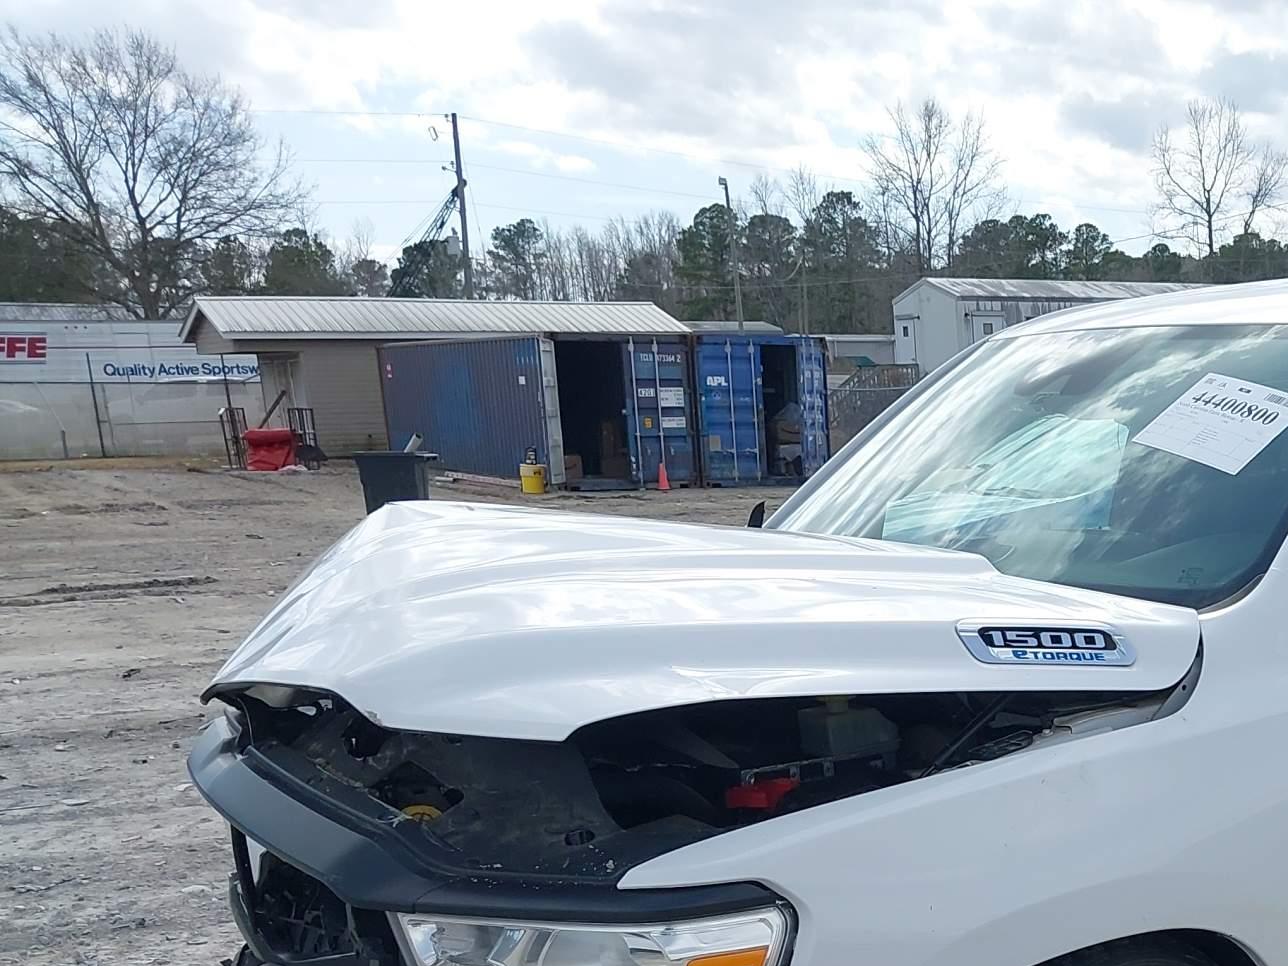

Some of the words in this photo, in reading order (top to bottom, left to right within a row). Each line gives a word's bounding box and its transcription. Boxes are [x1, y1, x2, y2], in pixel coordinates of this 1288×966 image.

[103, 363, 155, 378] Quality
[158, 362, 199, 376] Active
[706, 376, 728, 386] APL
[1191, 391, 1279, 425] 44400800
[984, 630, 1106, 649] 1500
